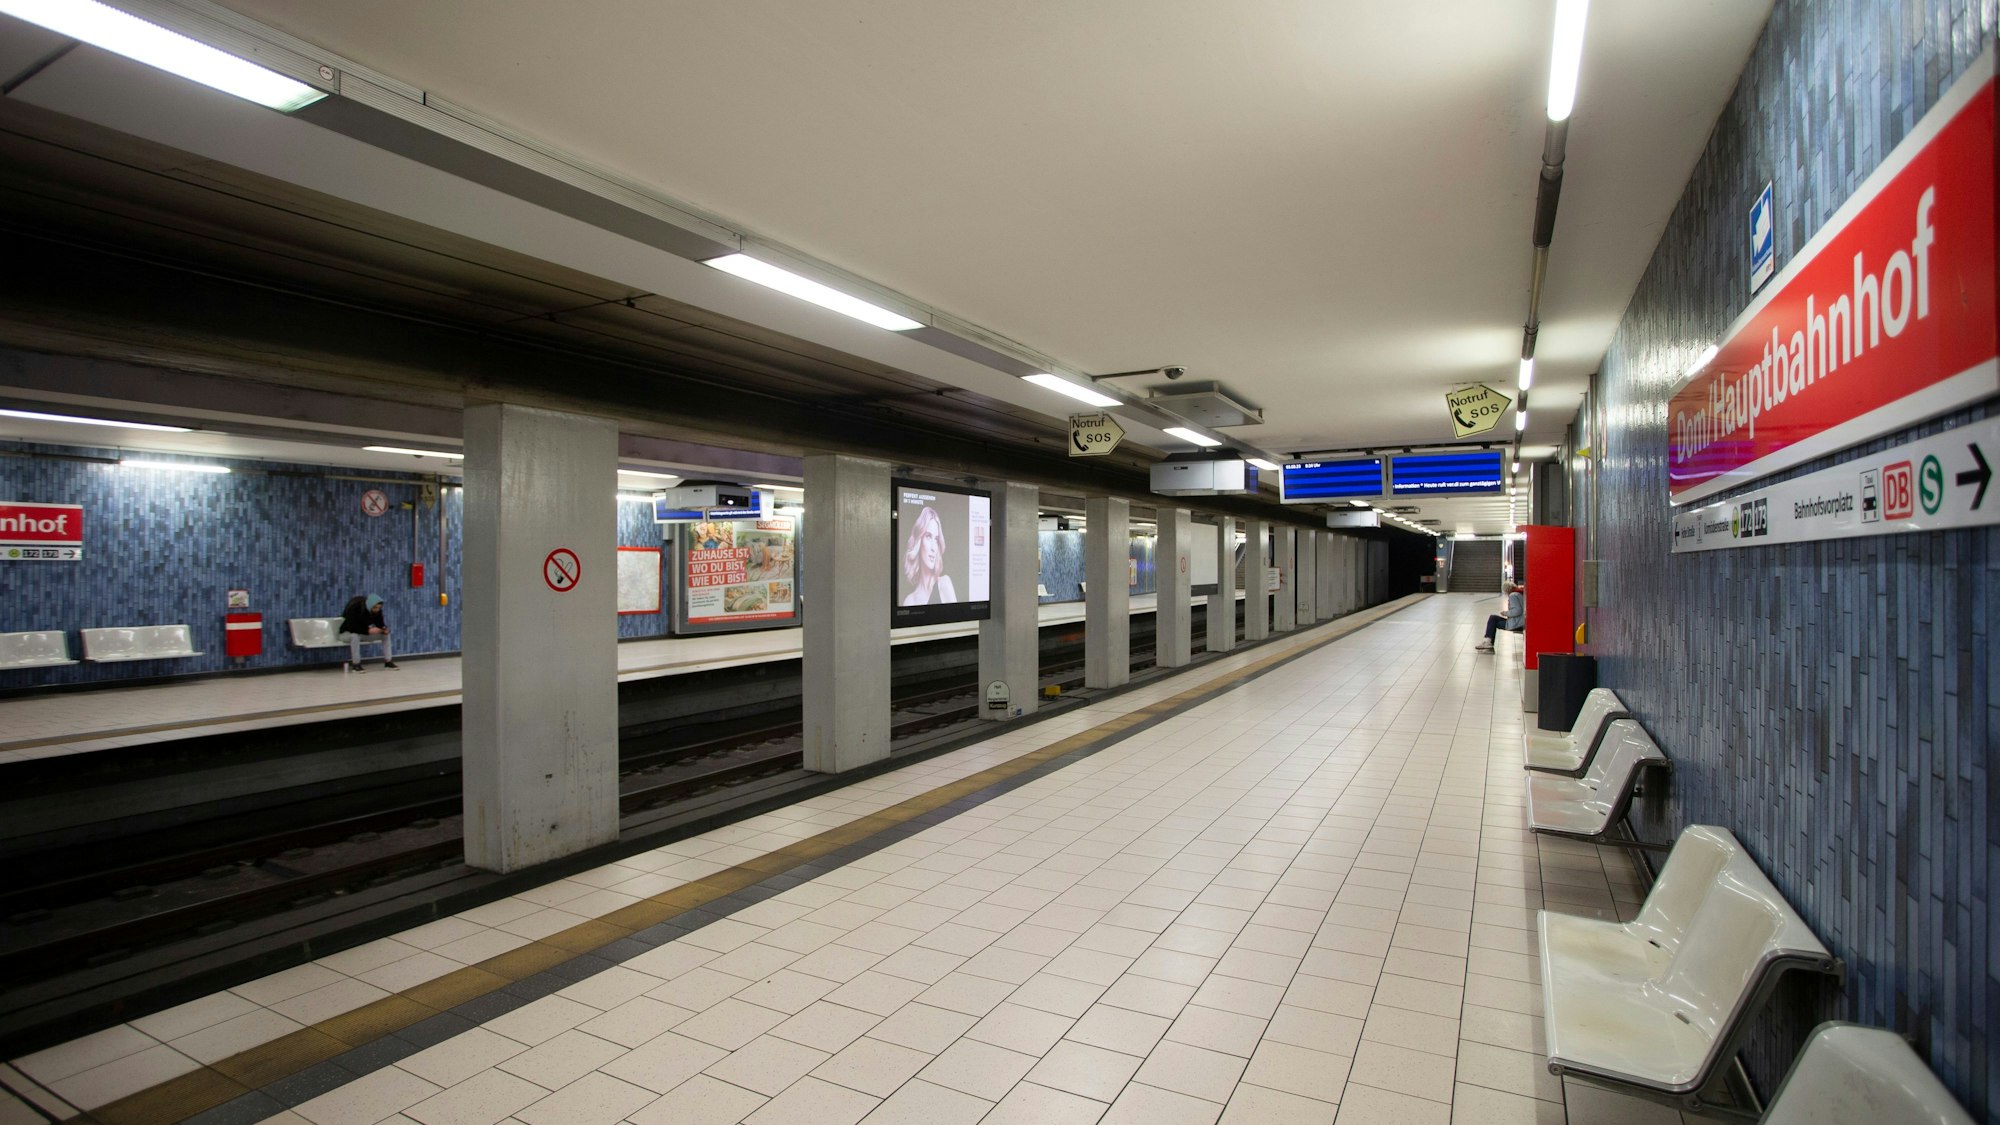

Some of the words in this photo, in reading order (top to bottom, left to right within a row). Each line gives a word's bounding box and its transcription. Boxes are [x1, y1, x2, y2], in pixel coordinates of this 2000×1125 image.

[1677, 185, 1934, 465] Dom/Hauptbahnhof
[1450, 390, 1489, 408] Notruf
[1470, 403, 1500, 419] SOS
[1072, 417, 1105, 428] Notruf
[1086, 433, 1111, 443] SOS
[1794, 492, 1853, 519] Bahnhofsvorplatz
[1887, 471, 1909, 510] DB
[1741, 508, 1752, 532] 172
[1755, 504, 1766, 531] 173
[692, 549, 734, 560] ZUHAUSE
[736, 548, 750, 558] IST,
[692, 563, 708, 573] WO
[710, 562, 723, 572] DU
[726, 560, 745, 571] BIST,
[692, 575, 710, 586] WIE
[712, 574, 724, 585] DU
[727, 573, 747, 584] BIST.
